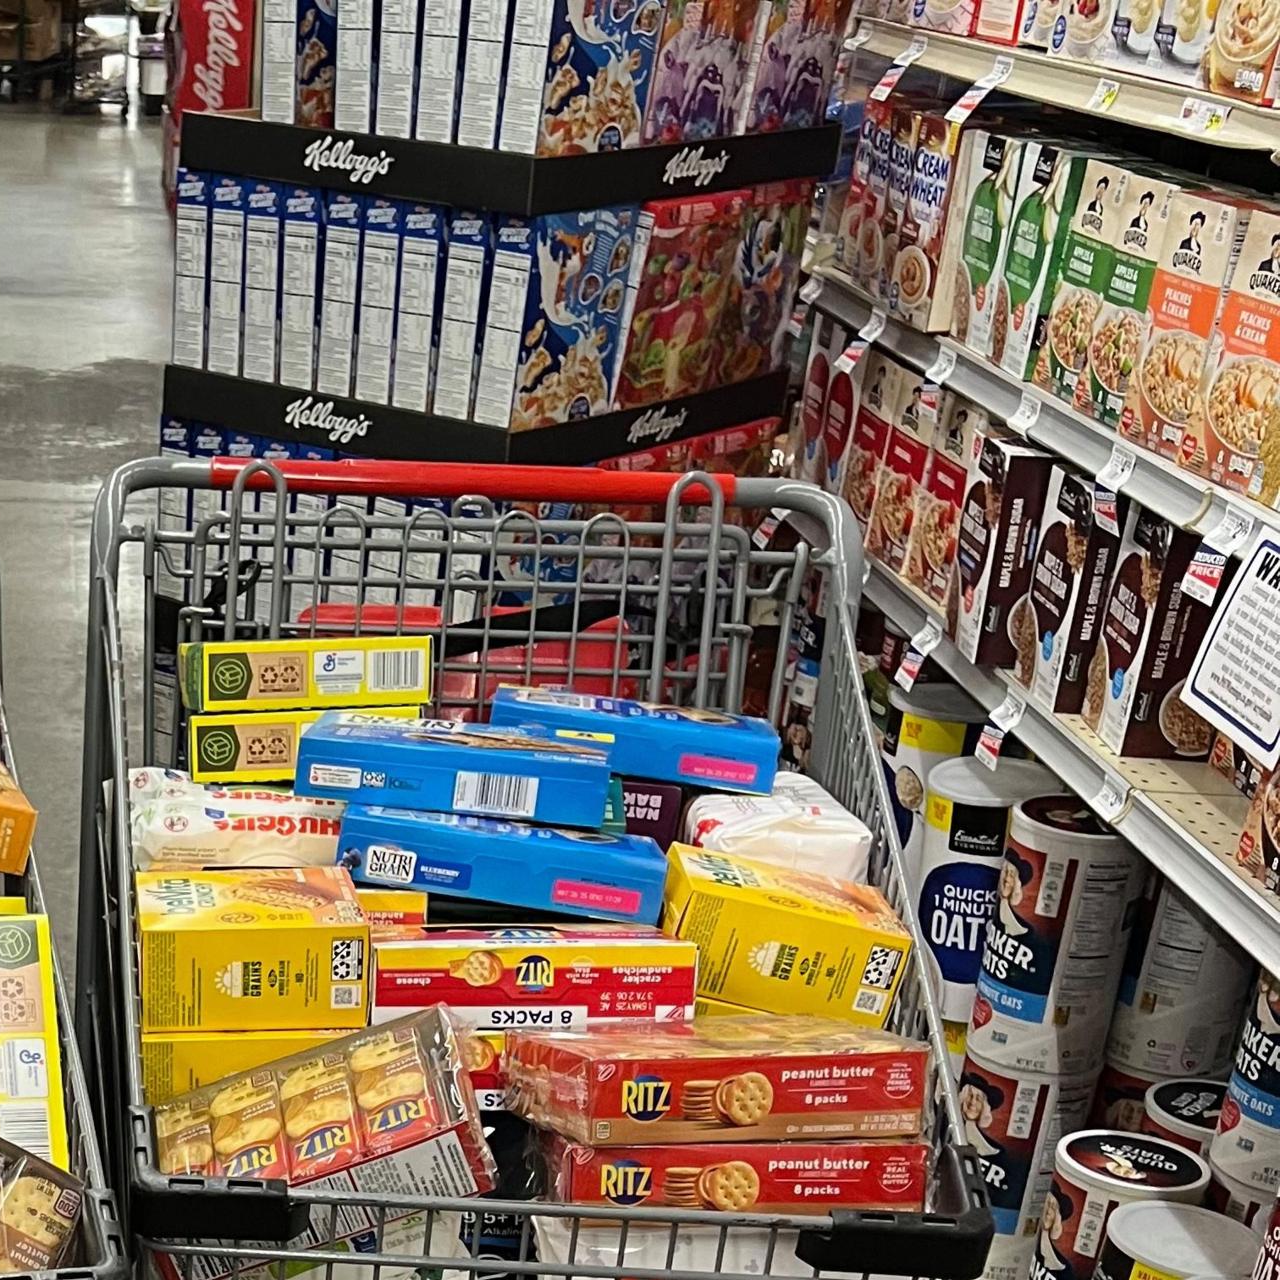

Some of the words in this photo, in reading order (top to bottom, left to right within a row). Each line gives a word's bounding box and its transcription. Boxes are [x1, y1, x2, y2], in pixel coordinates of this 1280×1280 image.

[303, 135, 395, 184] Kellogg's
[663, 146, 731, 186] Kellogg's
[917, 146, 949, 178] CREAM
[911, 181, 945, 208] WHEAT
[1123, 231, 1148, 250] QUAKER
[1172, 252, 1202, 274] QUAKER
[1164, 287, 1192, 307] PEACHES
[1166, 302, 1190, 321] CREAM
[1239, 310, 1272, 330] PEACHES
[1241, 328, 1267, 345] CREAM
[285, 397, 373, 444] Kellogg's
[628, 408, 687, 443] Kellogg's
[1095, 547, 1109, 575] SUGAR
[1195, 551, 1226, 566] REDUCED
[999, 560, 1011, 588] MAPLE
[1188, 564, 1220, 579] PRICE
[1090, 575, 1103, 602] BROWN
[1081, 611, 1095, 641] MAPLE
[1152, 649, 1167, 679] MAPLE
[217, 814, 341, 836] HUGGIES
[954, 830, 999, 846] Essential
[371, 850, 413, 867] NUTRI
[370, 862, 411, 879] GRAIN
[420, 864, 459, 878] BLUEBERRY
[943, 884, 996, 902] QUICK
[934, 895, 940, 908] 1
[942, 898, 994, 917] MINUT
[613, 966, 672, 975] sandwiches
[778, 945, 799, 981] GRAINS
[250, 960, 263, 998] GRAINS
[395, 977, 432, 986] cheese
[517, 960, 554, 987] RITZ
[622, 974, 661, 984] cracker
[1000, 994, 1023, 1011] OATS
[491, 1010, 553, 1024] PACKS
[560, 1010, 573, 1024] 8
[781, 1067, 829, 1083] peanut
[833, 1064, 875, 1080] butter
[886, 1079, 911, 1087] PEANUT
[621, 1080, 672, 1113] RITZ
[805, 1094, 813, 1104] 8
[814, 1093, 848, 1107] packs
[1250, 1097, 1274, 1116] OATS
[369, 1098, 425, 1135] RITZ
[295, 1123, 352, 1162] RITZ
[224, 1144, 278, 1178] RITZ
[1099, 1141, 1179, 1173] QUAKER
[1120, 1144, 1166, 1162] OATS
[768, 1157, 820, 1174] peanut
[824, 1157, 870, 1172] butter
[886, 1165, 906, 1174] REAL
[600, 1165, 652, 1198] RITZ
[883, 1172, 911, 1180] PEANUT
[793, 1184, 803, 1196] 8
[804, 1184, 840, 1199] packs
[15, 1238, 51, 1263] butter
